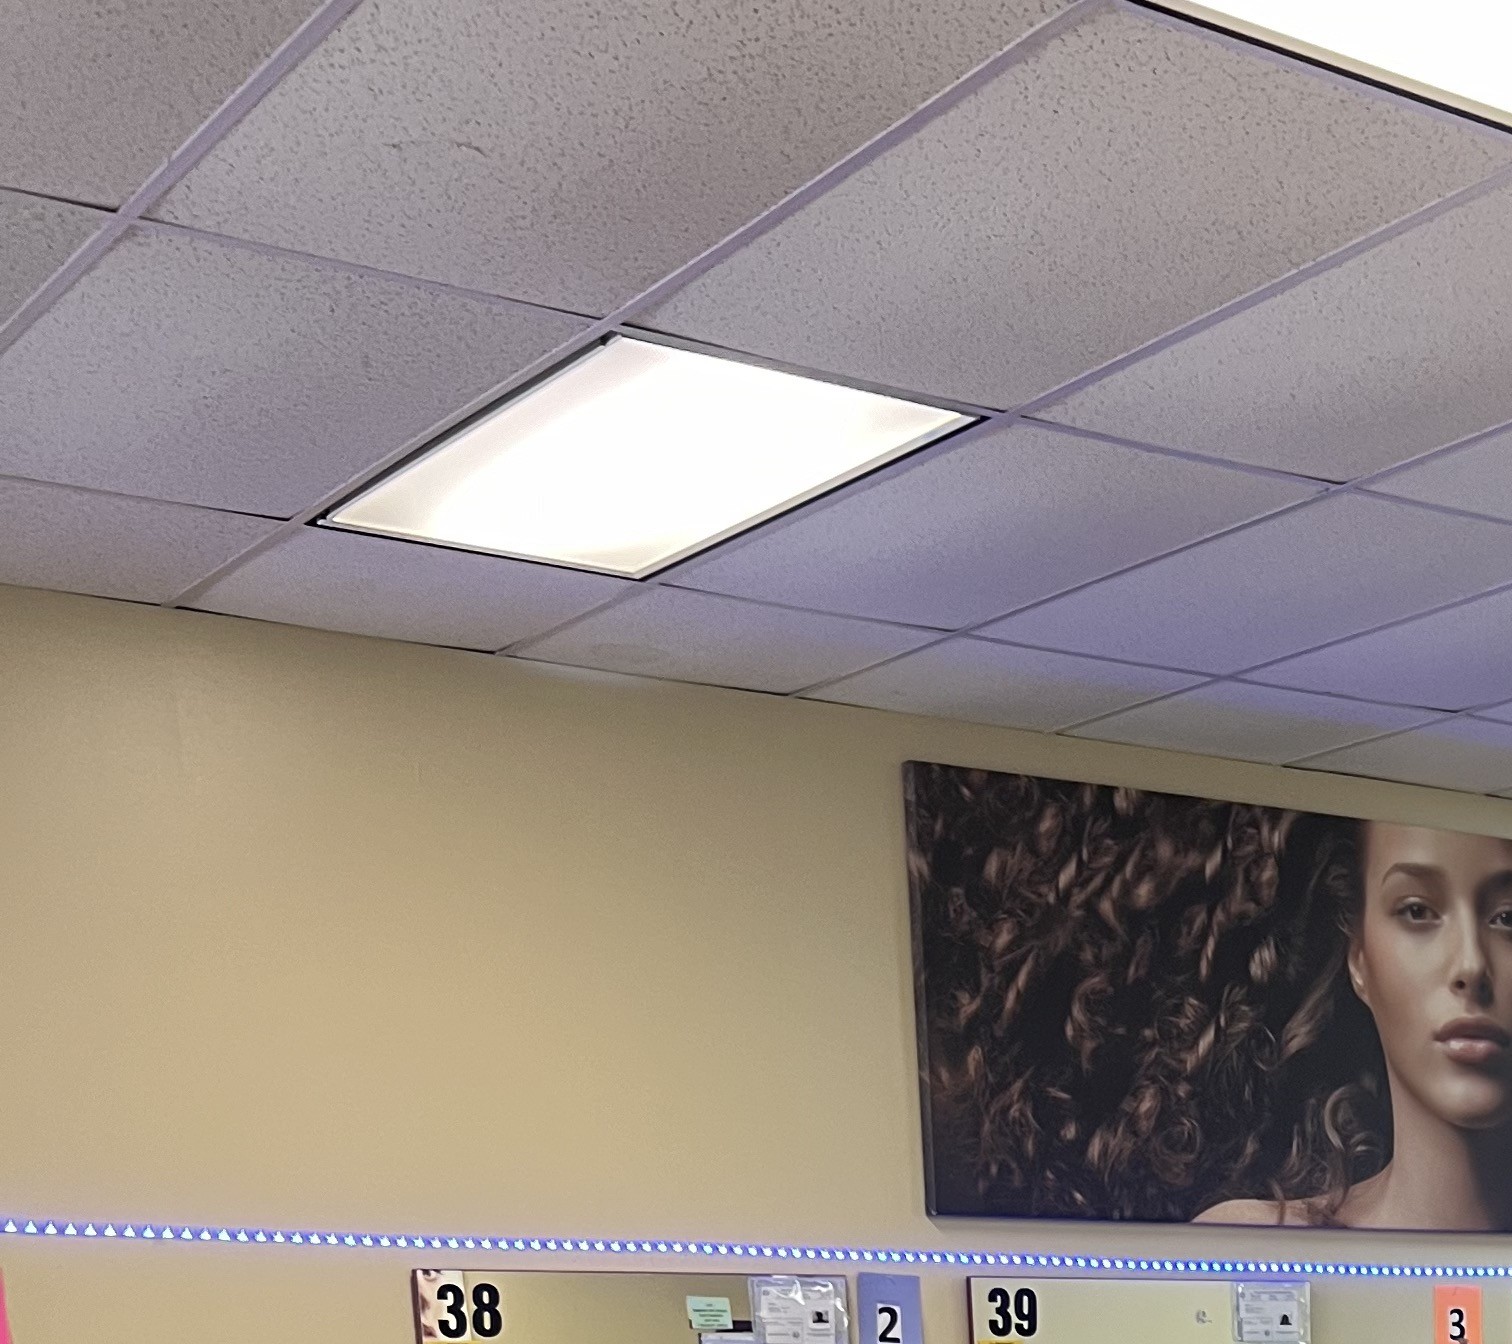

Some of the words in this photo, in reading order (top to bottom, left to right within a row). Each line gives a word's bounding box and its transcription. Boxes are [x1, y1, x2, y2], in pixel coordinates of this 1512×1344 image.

[436, 1283, 502, 1339] 38
[878, 1307, 901, 1343] 2
[987, 1288, 1038, 1337] 39
[1448, 1309, 1466, 1341] 3
